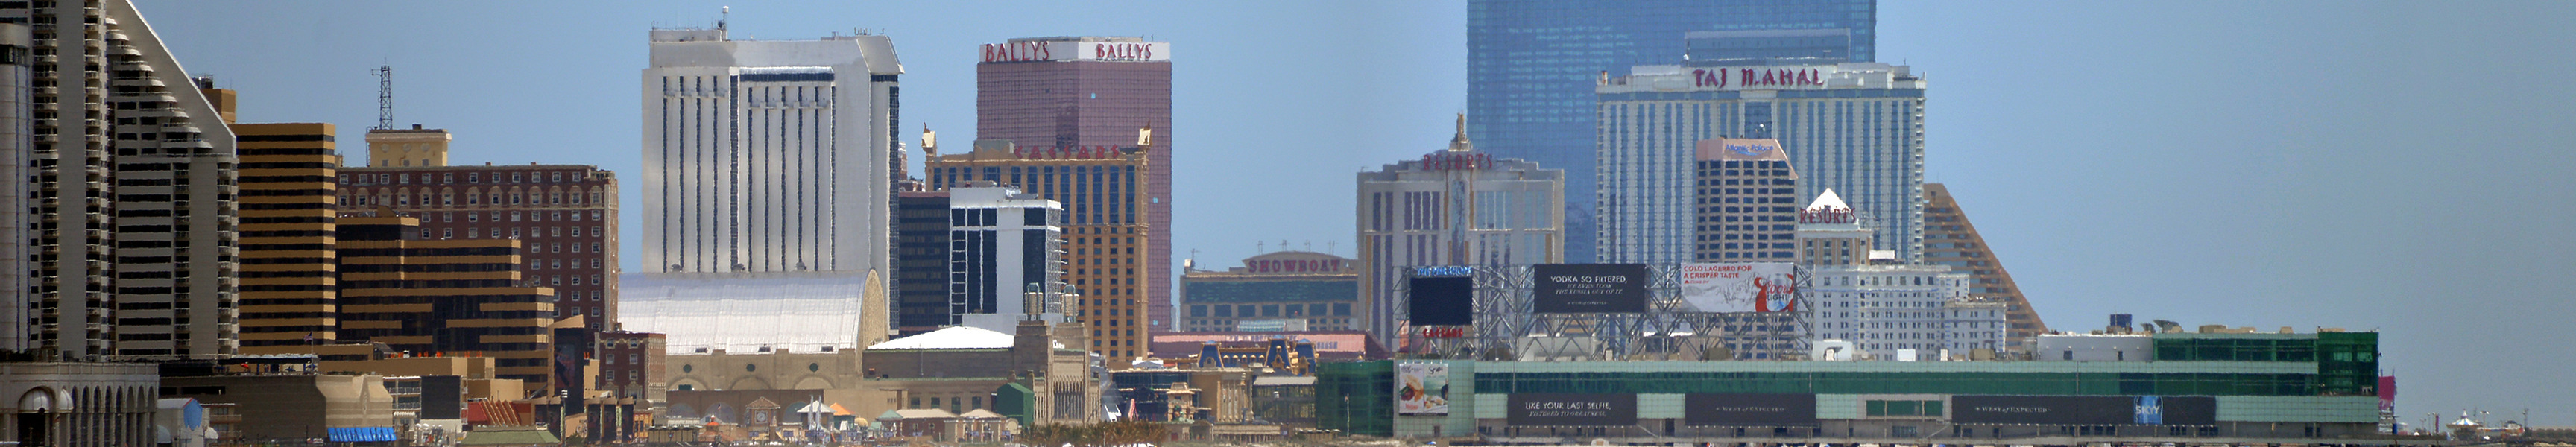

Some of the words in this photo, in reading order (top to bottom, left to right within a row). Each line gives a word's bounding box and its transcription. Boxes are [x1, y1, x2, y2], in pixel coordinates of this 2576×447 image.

[985, 41, 1049, 62] BALLYS
[1096, 43, 1152, 60] BALLYS
[1693, 68, 1727, 88] TAJ
[1741, 68, 1825, 86] MAHAL
[1014, 144, 1119, 159] CAESARS
[1423, 153, 1493, 171] RESORTS
[1799, 206, 1857, 224] RESORTS
[1248, 259, 1341, 273] SHOWBOAT
[1525, 402, 1541, 410] LIKE
[1543, 402, 1564, 410] YOUR
[1566, 402, 1584, 410] LAST
[2135, 405, 2160, 415] SKYY
